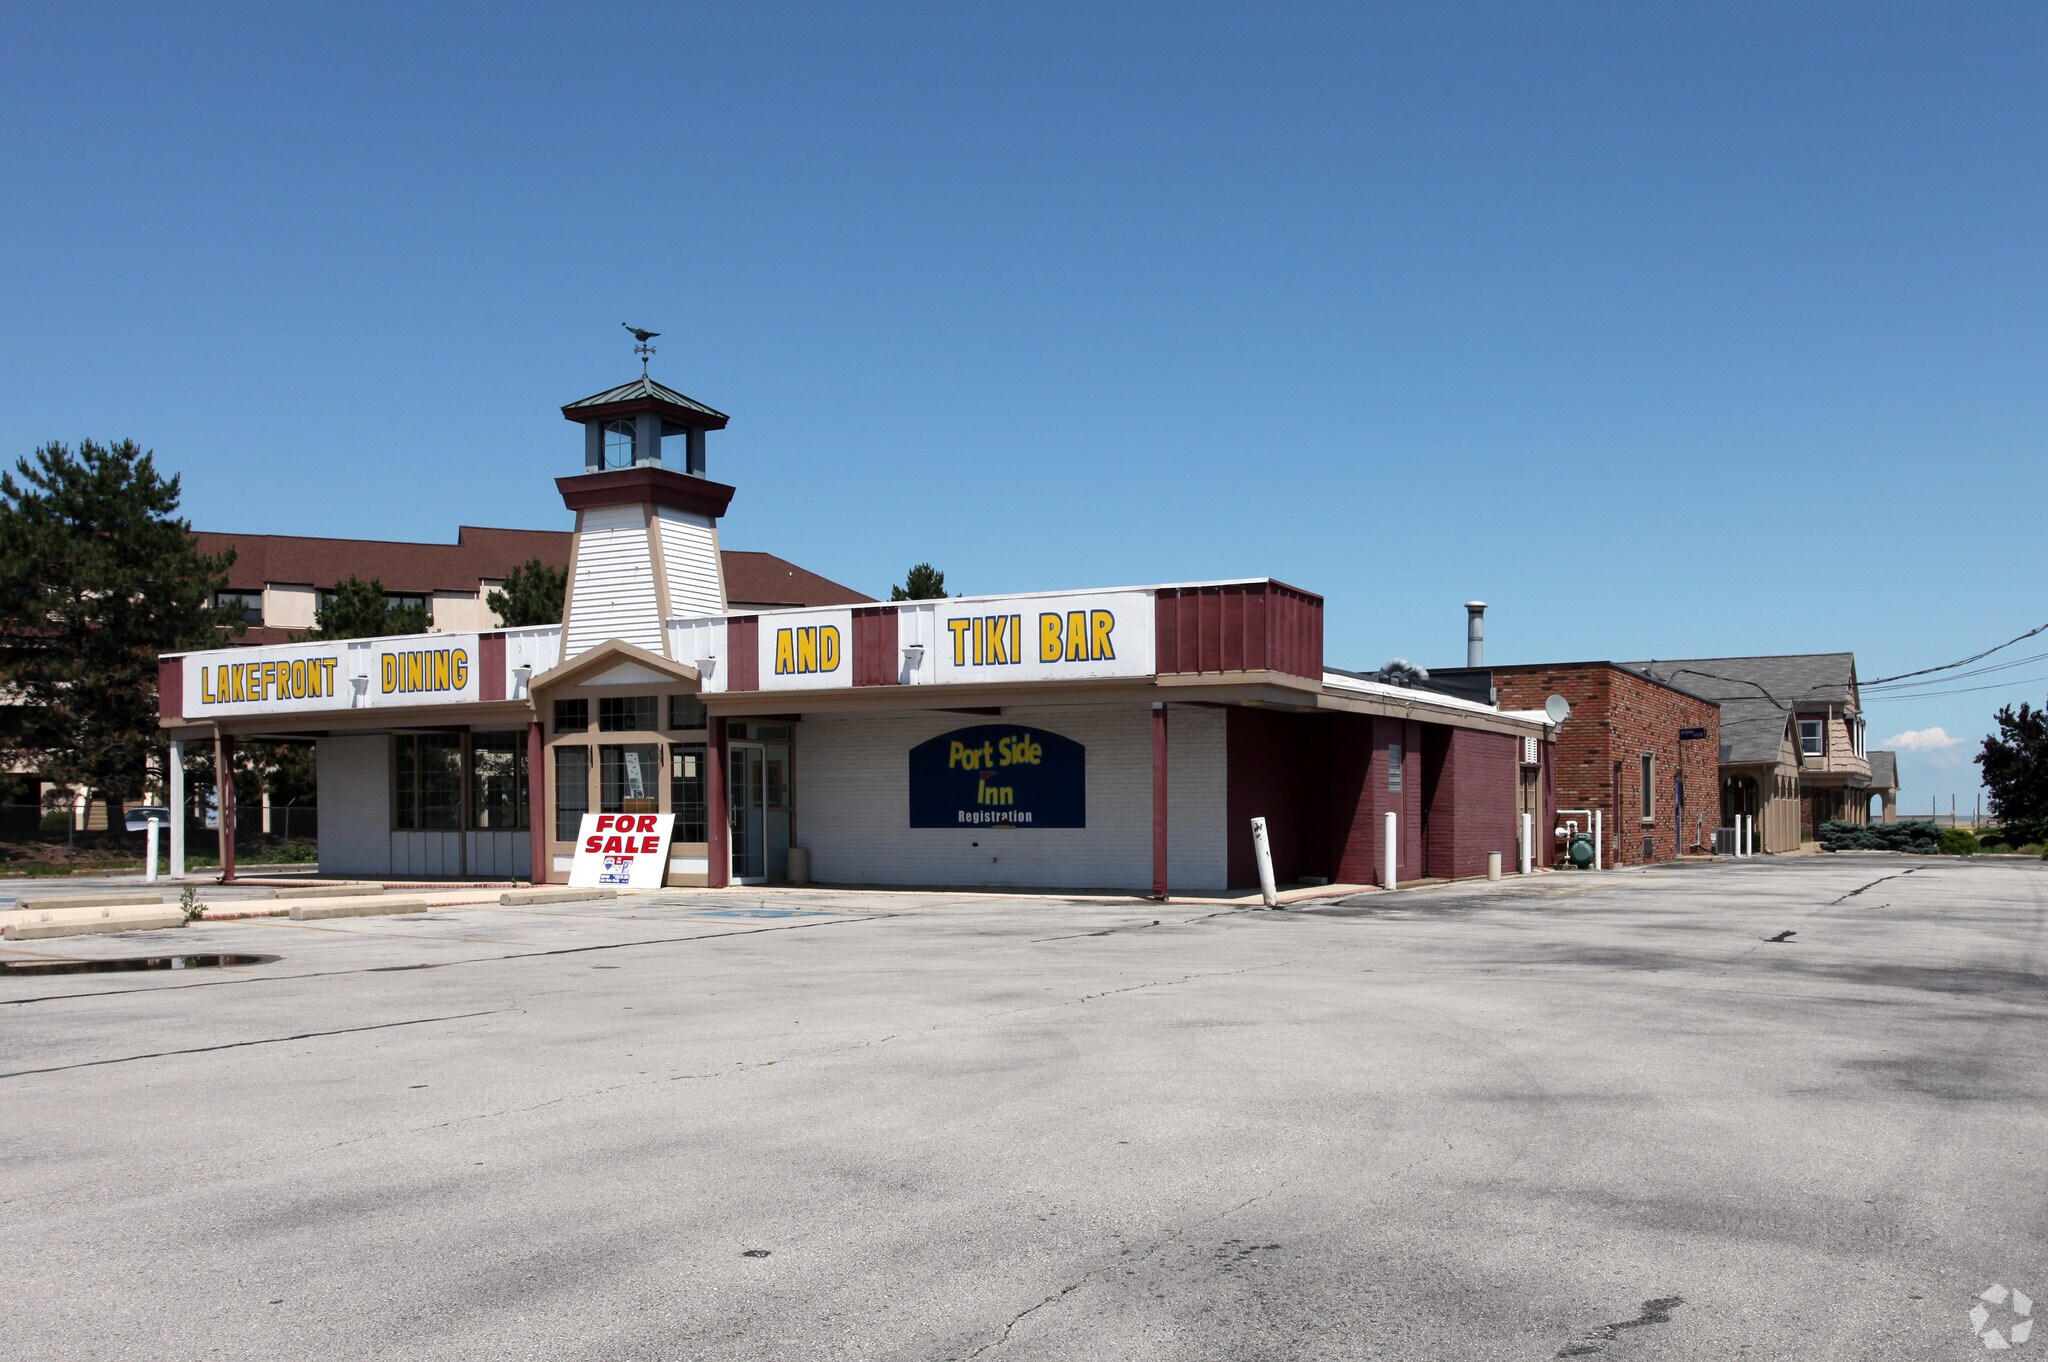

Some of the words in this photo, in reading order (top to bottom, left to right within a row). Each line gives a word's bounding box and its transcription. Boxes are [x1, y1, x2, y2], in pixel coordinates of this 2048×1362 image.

[774, 625, 841, 675] AND
[947, 614, 1021, 667] TIKI
[1038, 609, 1116, 663] BAR
[201, 656, 338, 704] LAKEFRONT
[381, 648, 468, 694] DINING
[949, 740, 993, 770] Port
[998, 733, 1042, 766] Side
[977, 779, 1013, 805] Inn
[596, 815, 657, 833] FOR
[958, 810, 1032, 824] Registration
[585, 836, 660, 853] SALE
